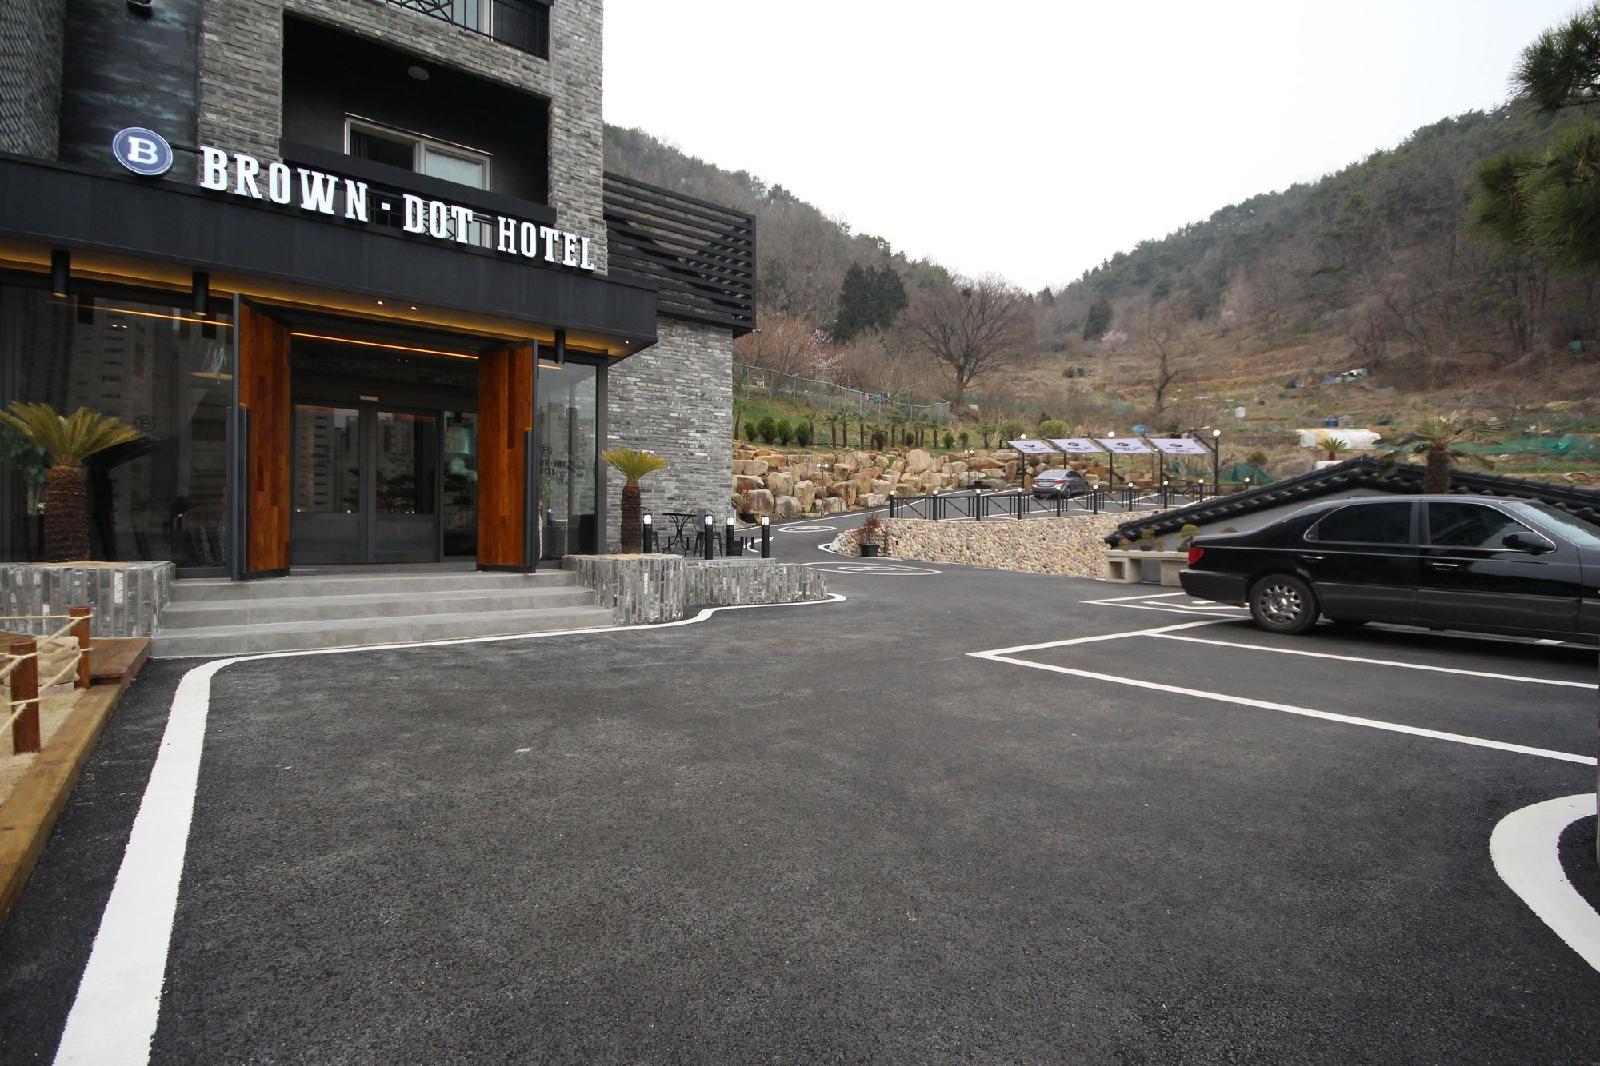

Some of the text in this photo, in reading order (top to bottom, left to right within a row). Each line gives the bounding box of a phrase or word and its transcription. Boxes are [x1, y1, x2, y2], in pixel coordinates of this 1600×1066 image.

[127, 136, 159, 165] B
[200, 145, 369, 223] BROWN
[402, 193, 473, 245] DOT
[497, 215, 595, 271] HOTEL
